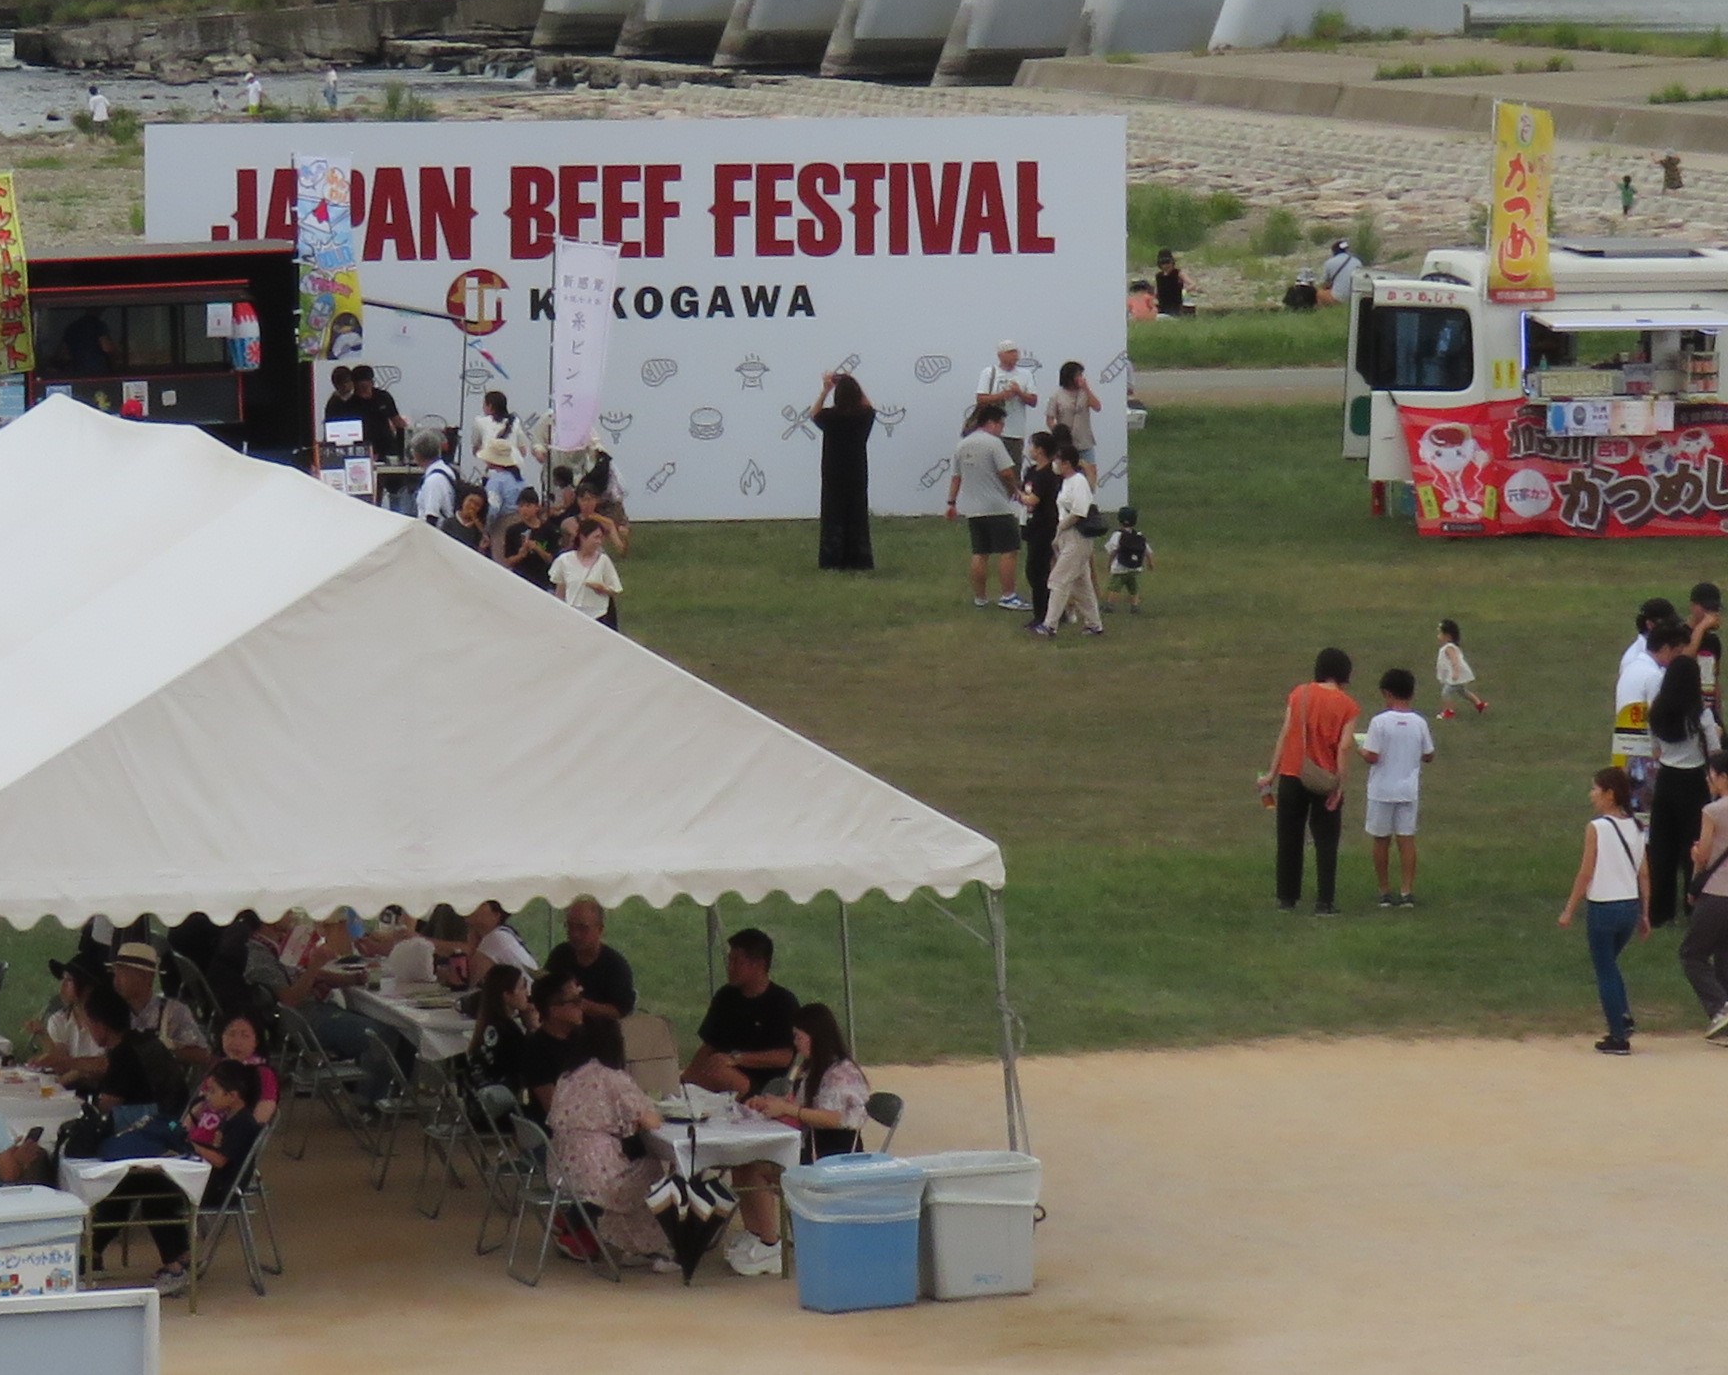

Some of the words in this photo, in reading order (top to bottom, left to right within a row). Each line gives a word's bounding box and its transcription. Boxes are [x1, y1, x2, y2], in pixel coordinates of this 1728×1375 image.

[211, 165, 479, 261] JAAN
[503, 163, 682, 260] BEEF
[707, 161, 1056, 257] FESTIVAL
[530, 285, 816, 319] KOGAWA
